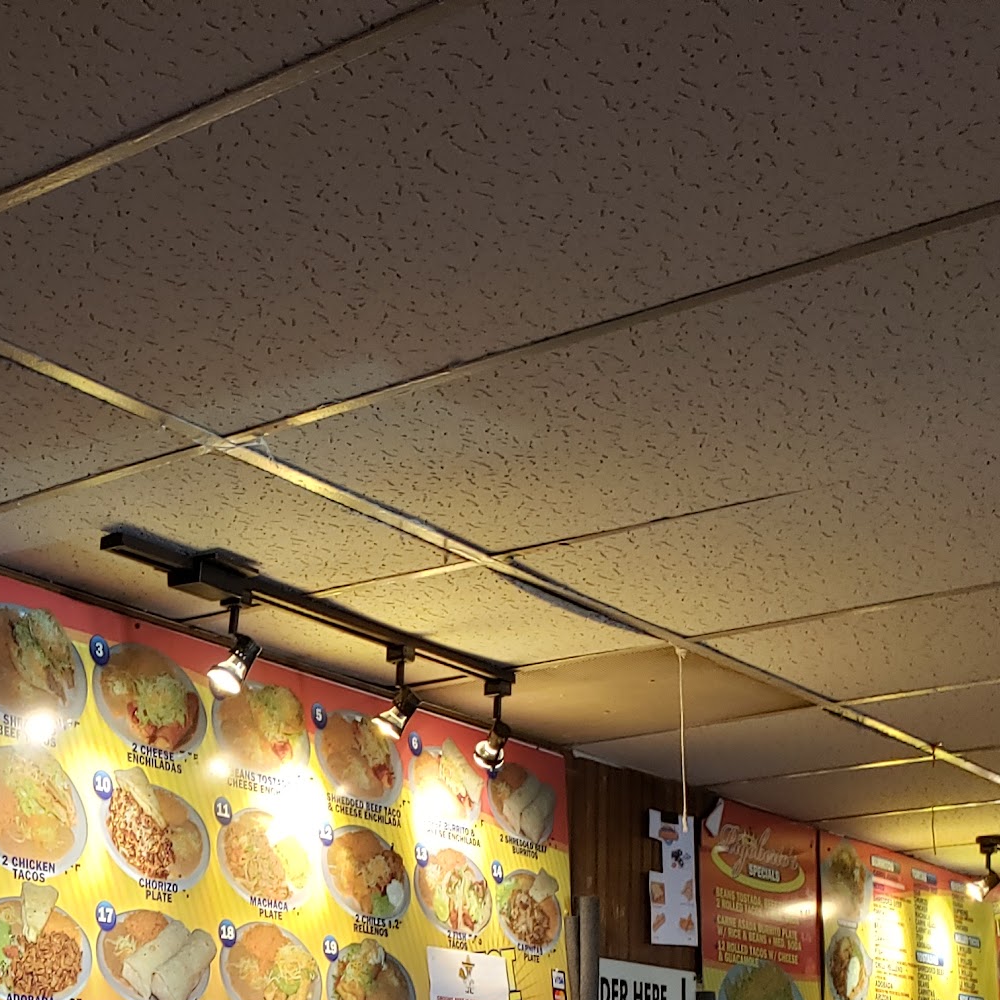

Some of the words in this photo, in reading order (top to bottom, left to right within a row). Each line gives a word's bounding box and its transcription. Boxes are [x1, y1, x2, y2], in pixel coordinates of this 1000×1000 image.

[95, 642, 104, 657] 3
[315, 709, 322, 722] 5
[132, 742, 139, 752] 2
[140, 746, 175, 762] CHEESE
[127, 753, 182, 774] ENCHILADAS
[95, 775, 111, 792] 10
[216, 803, 230, 818] 11
[326, 792, 364, 810] SHREDDED
[366, 802, 383, 814] BEEF
[384, 806, 401, 818] TACO
[335, 804, 363, 818] CHEESE
[364, 811, 402, 828] ENCHILADA
[2, 855, 9, 867] 2
[11, 856, 56, 874] CHICKEN
[492, 863, 503, 878] 14
[12, 867, 46, 883] TACOS
[748, 864, 781, 883] SPECIALS
[138, 878, 179, 893] CHORIZO
[145, 890, 173, 903] PLATE
[249, 896, 289, 911] MACHACA
[97, 907, 113, 923] 17
[258, 908, 283, 921] PLATE
[355, 914, 360, 923] 2
[220, 924, 235, 940] 18
[716, 914, 737, 928] CARNE
[738, 919, 757, 931] ASADA
[758, 922, 780, 936] BURRITO
[782, 926, 798, 939] PLATE
[447, 929, 452, 940] 2
[453, 931, 467, 942] FISH
[728, 927, 741, 940] RICE
[748, 931, 767, 944] BEANS
[323, 940, 338, 955] 19
[448, 939, 468, 950] TACOS
[523, 952, 540, 964] PLATE
[726, 942, 749, 956] ROLLED
[749, 947, 768, 960] TACOS
[778, 952, 798, 965] CHEESE
